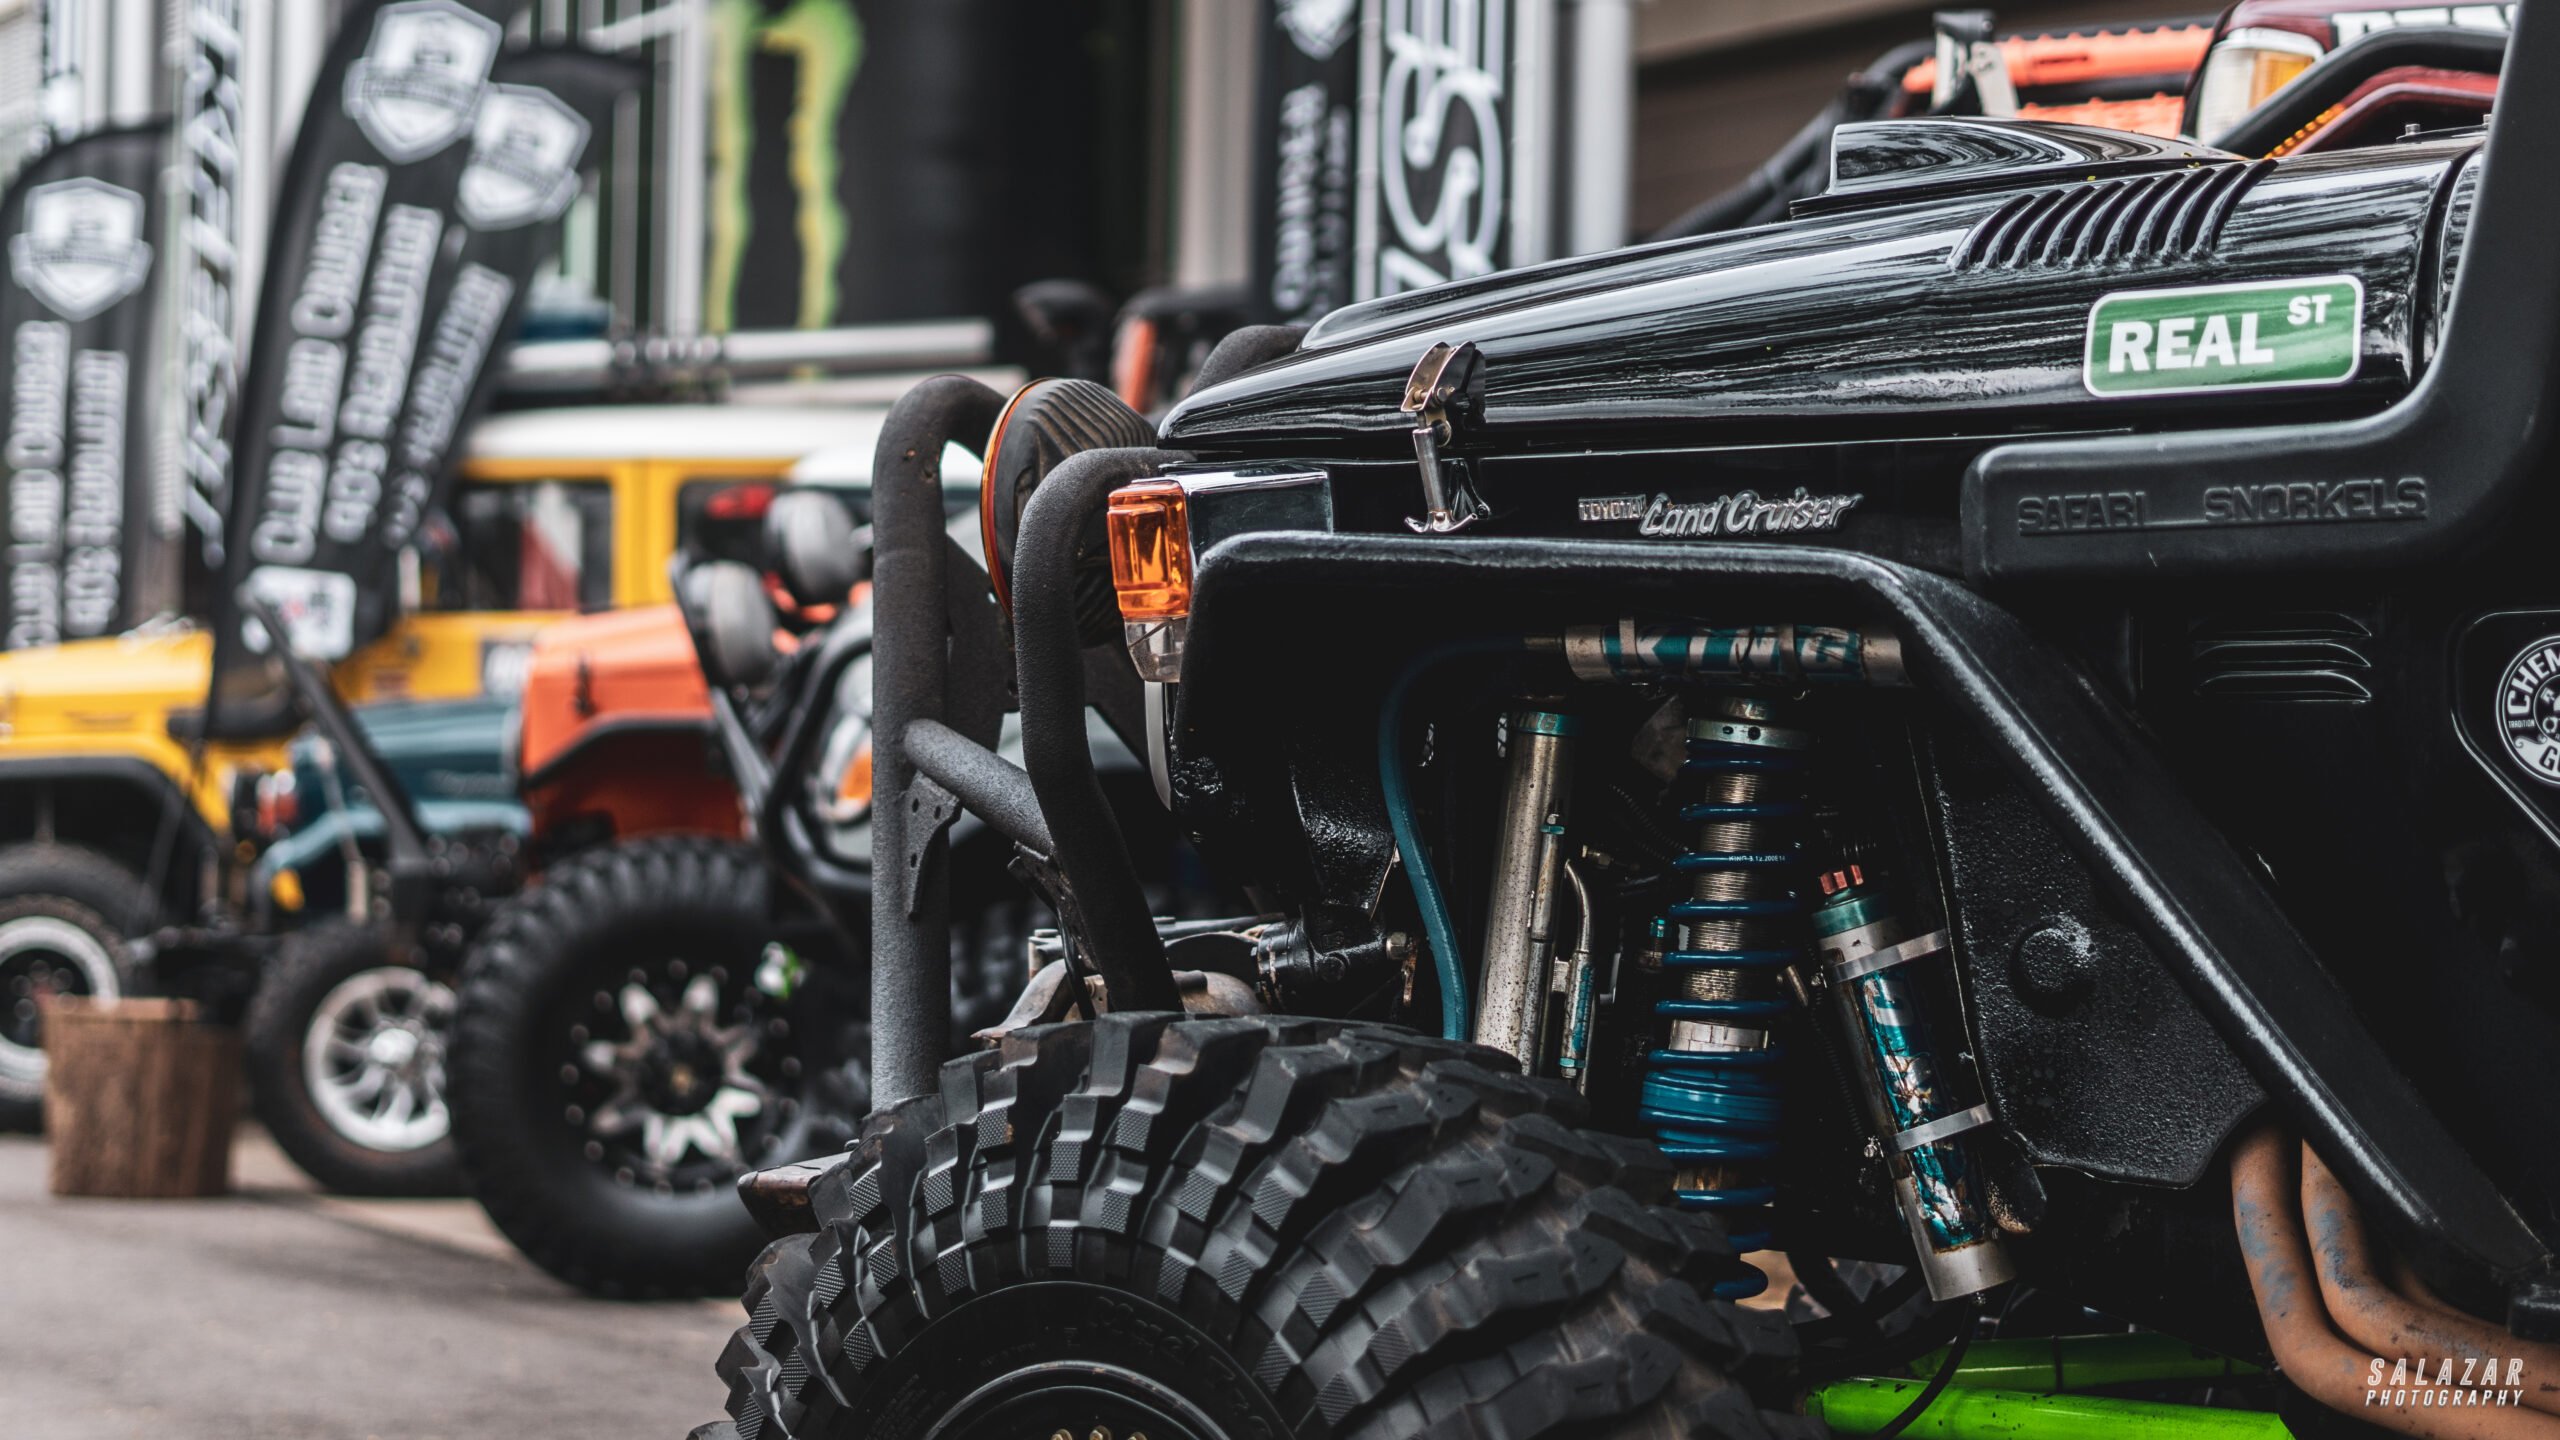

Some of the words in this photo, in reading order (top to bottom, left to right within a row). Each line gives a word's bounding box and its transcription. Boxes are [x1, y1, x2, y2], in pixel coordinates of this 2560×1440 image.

[2108, 312, 2275, 374] REAL
[2287, 294, 2332, 325] ST
[1579, 494, 1647, 521] TOYOTA
[1640, 492, 1729, 537] Land
[1725, 486, 1864, 534] Cruiser
[2018, 491, 2147, 531] SAFARI
[2204, 477, 2428, 523] SNORKELS
[2508, 719, 2536, 729] TRADITION
